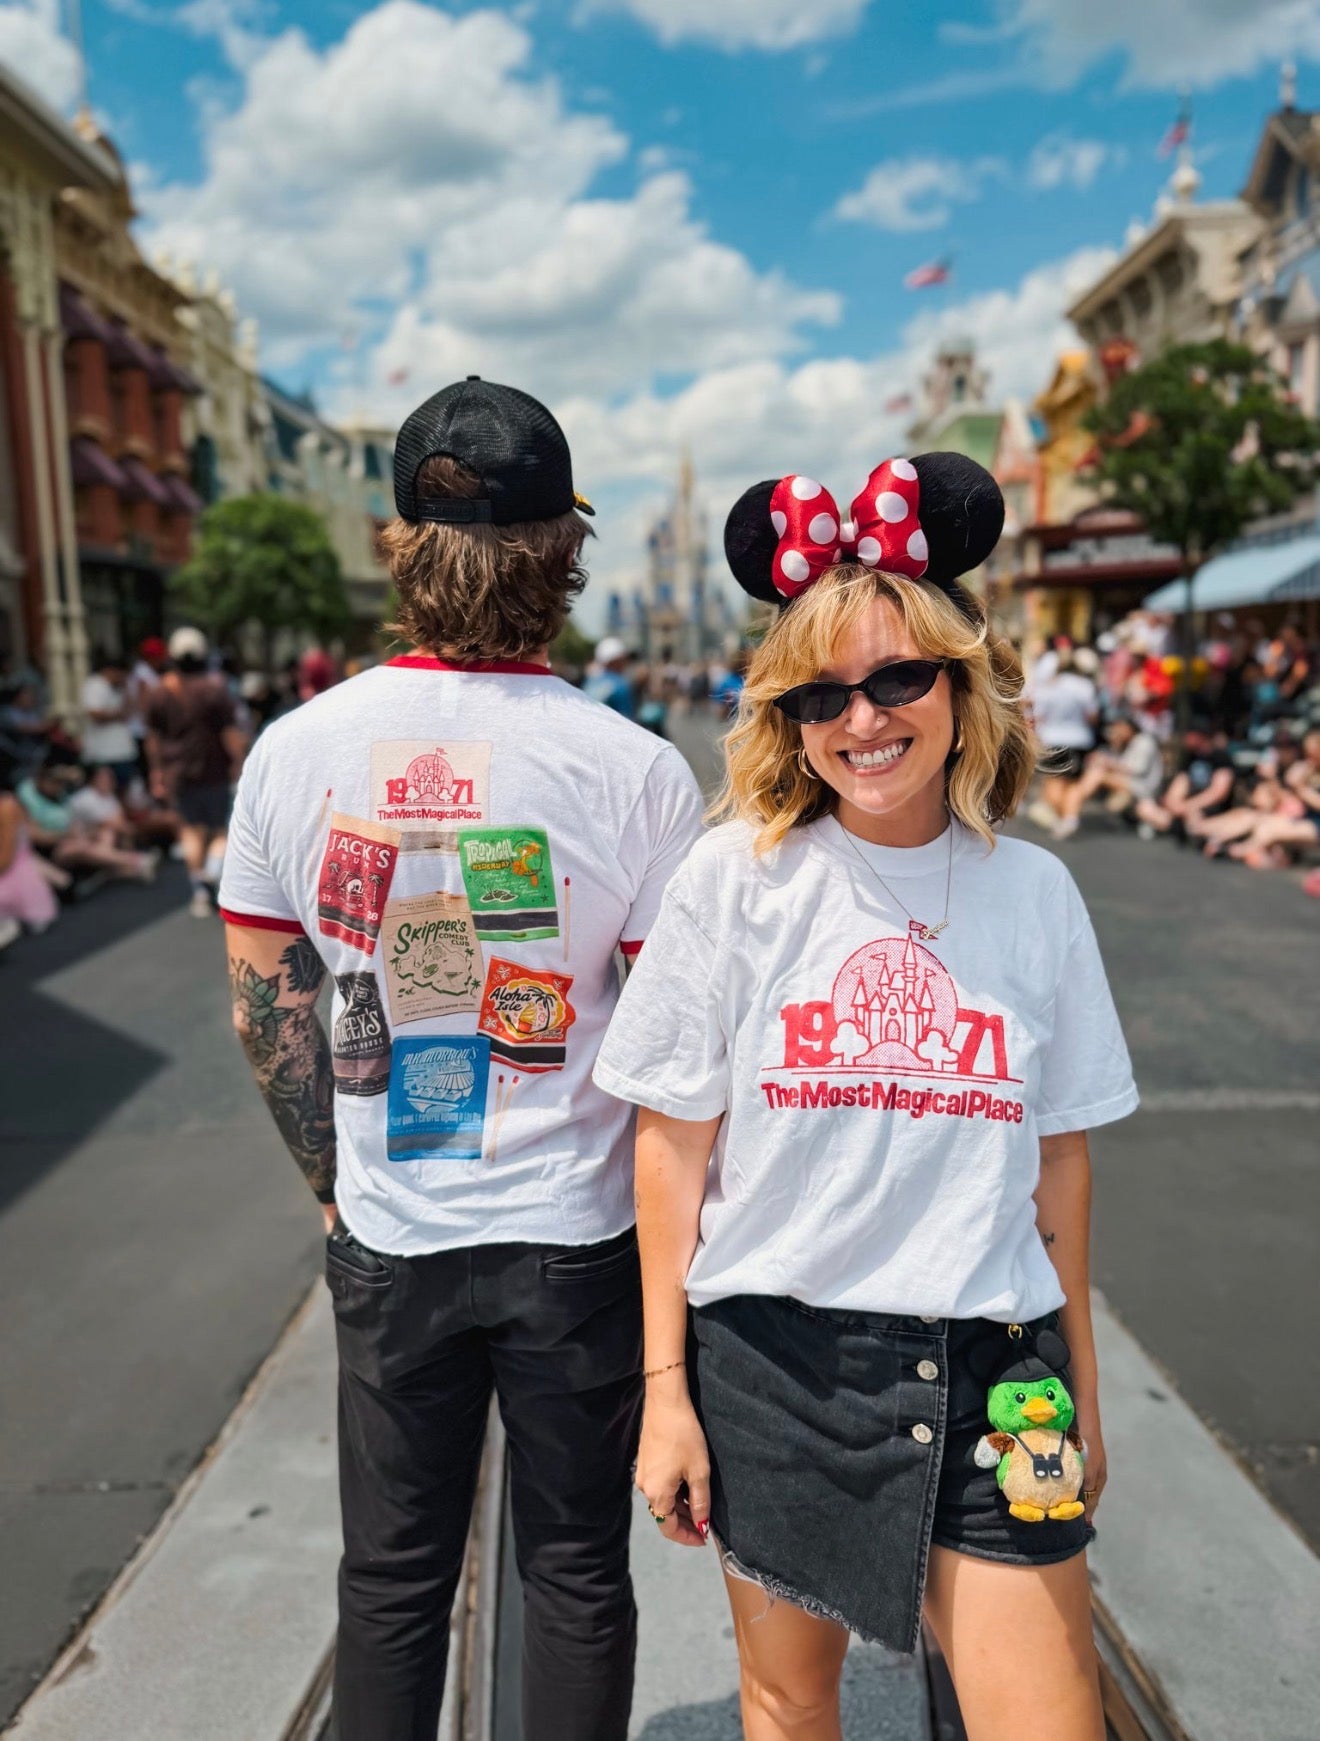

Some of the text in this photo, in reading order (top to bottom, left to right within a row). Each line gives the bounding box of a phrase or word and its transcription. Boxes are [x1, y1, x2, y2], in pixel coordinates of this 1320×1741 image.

[329, 834, 391, 868] JACK'S
[438, 932, 469, 942] COMEDY
[451, 939, 470, 948] CLUB
[489, 986, 531, 1001] Aloha
[495, 1001, 522, 1012] Isle
[780, 1001, 1009, 1080] 19 71
